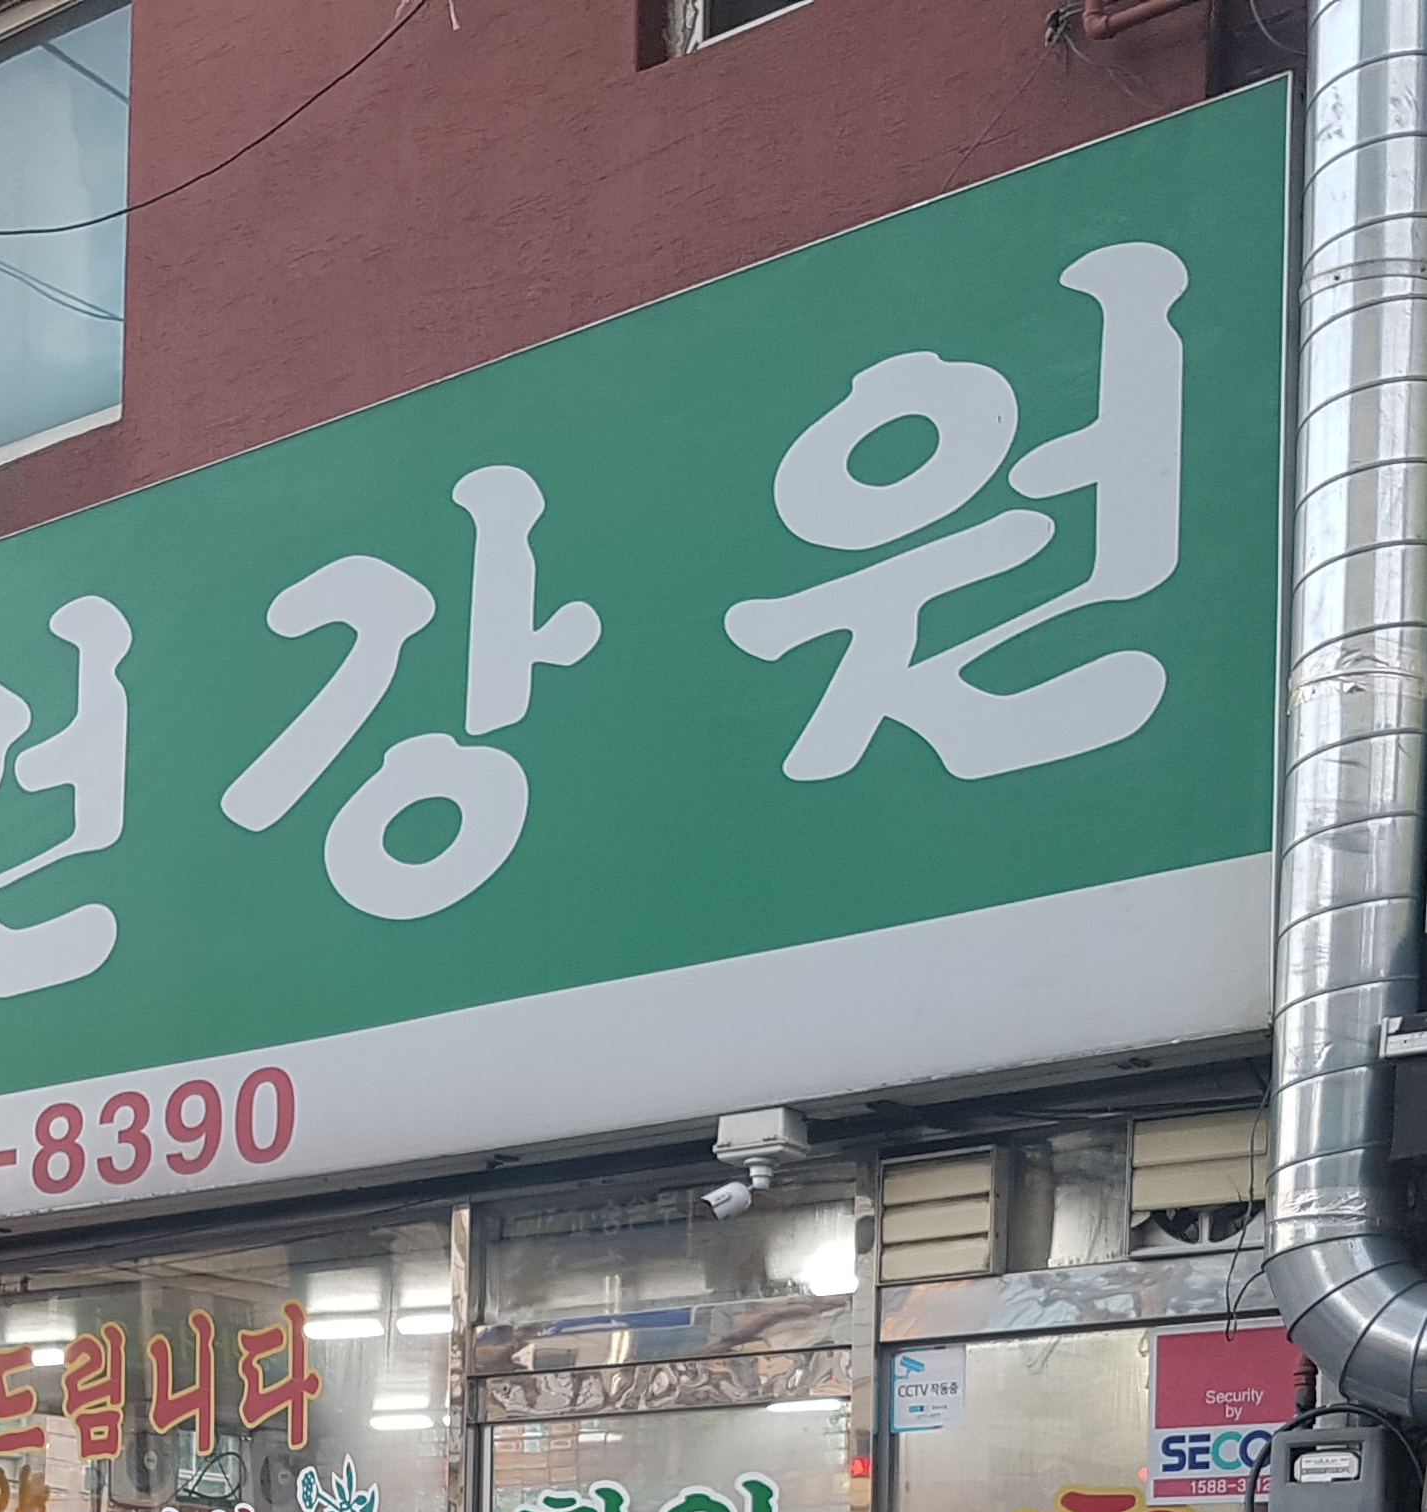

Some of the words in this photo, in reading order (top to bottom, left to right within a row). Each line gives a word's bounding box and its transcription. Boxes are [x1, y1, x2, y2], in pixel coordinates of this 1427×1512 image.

[898, 1384, 929, 1398] CCTV
[1205, 1388, 1264, 1406] Security
[1225, 1403, 1242, 1419] by
[1190, 1477, 1271, 1494] 1588-312
